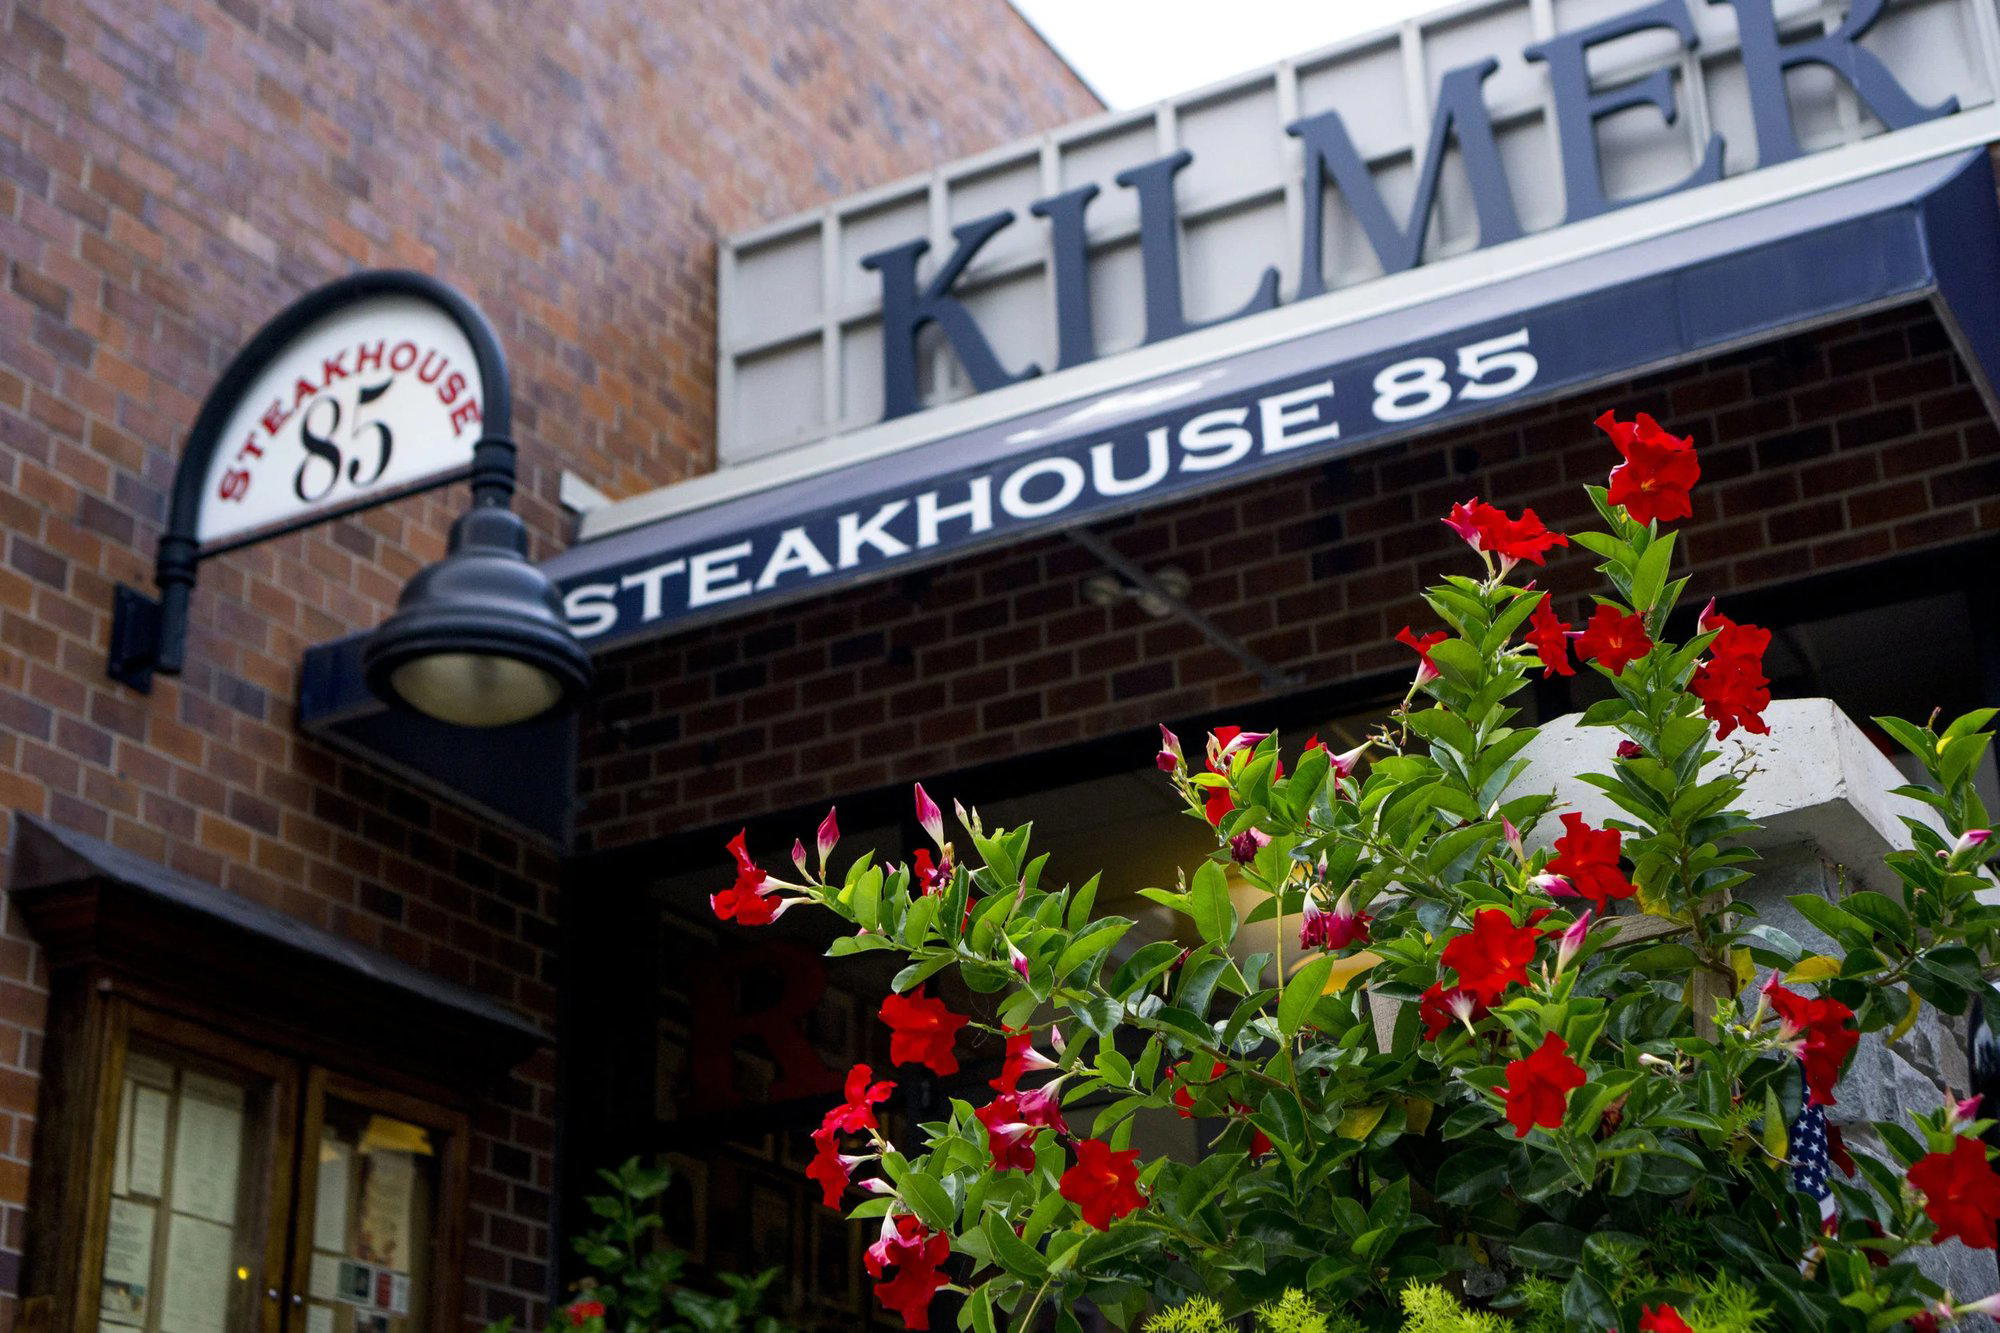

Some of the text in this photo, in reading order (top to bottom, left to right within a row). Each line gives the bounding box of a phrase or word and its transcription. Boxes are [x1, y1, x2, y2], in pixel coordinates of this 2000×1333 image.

[861, 0, 1961, 421] KILMER
[218, 340, 482, 502] STEAKHOUSE
[294, 376, 394, 502] 85
[563, 327, 1539, 638] STEAKHOUSE 85
